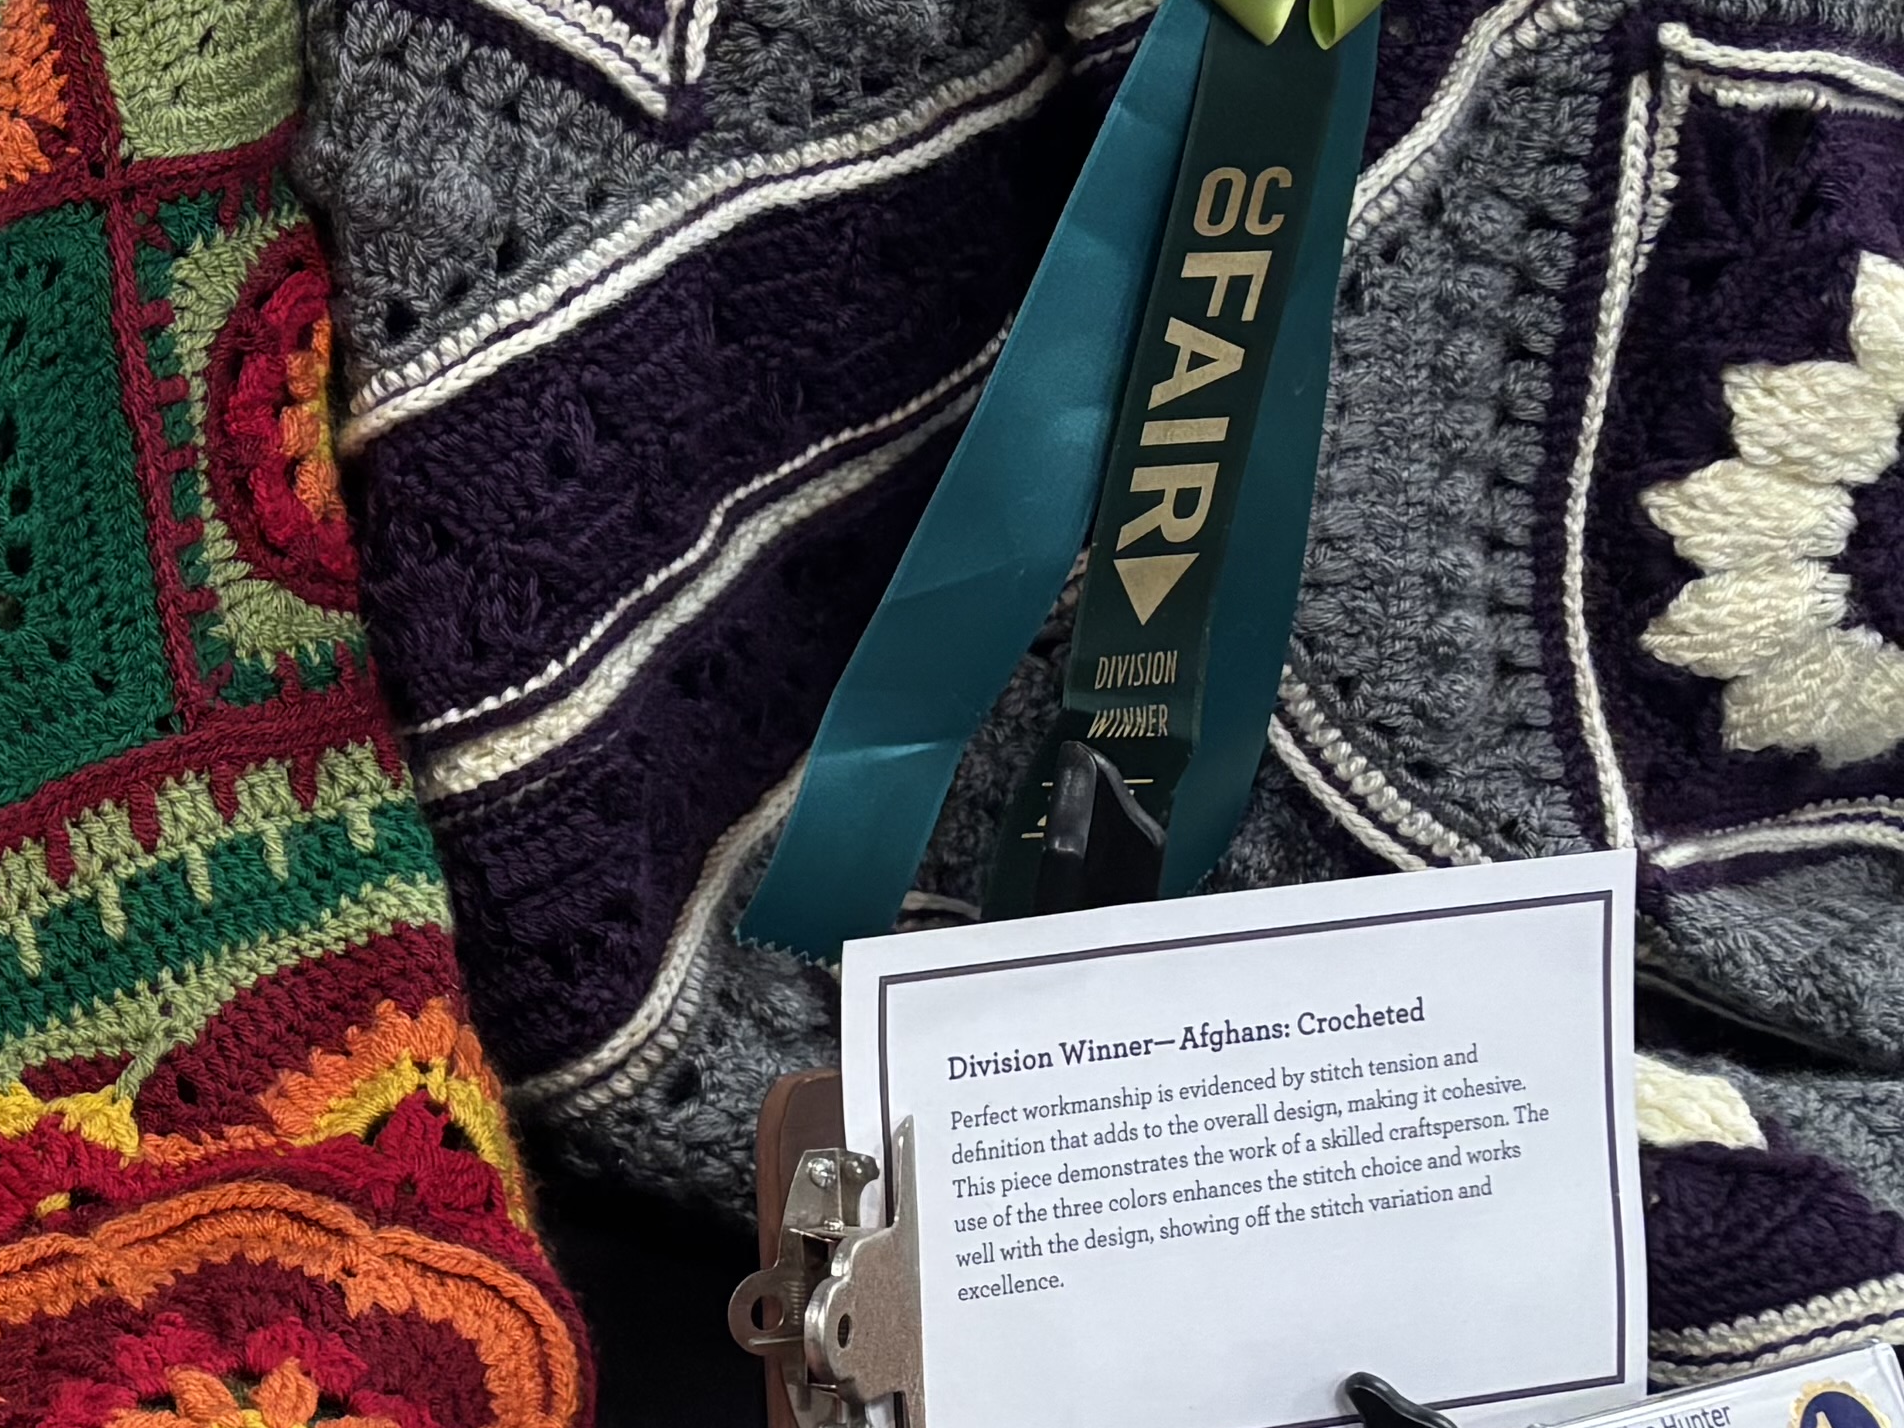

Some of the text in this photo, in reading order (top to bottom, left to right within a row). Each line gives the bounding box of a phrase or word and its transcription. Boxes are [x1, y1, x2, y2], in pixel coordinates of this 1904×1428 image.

[1194, 166, 1293, 237] OC
[1116, 250, 1274, 552] FAIR
[1094, 649, 1178, 689] DIVISION
[1087, 704, 1168, 739] WINNER
[947, 1048, 1054, 1081] Division
[1296, 995, 1425, 1036] Crocheted
[950, 1042, 1479, 1131] Perfect workmanship is evidenced by stitch tension and
[951, 1075, 1526, 1165] definition that adds to the overall design, making it cohesive.
[951, 1102, 1549, 1199] This piece demonstrates the work of a skilled craftsperson. The
[953, 1138, 1521, 1233] use of the three colors enhances the stitch choice and works
[955, 1174, 1493, 1268] well with the design, showing off the stitch variation and
[957, 1272, 1064, 1302] excellence.
